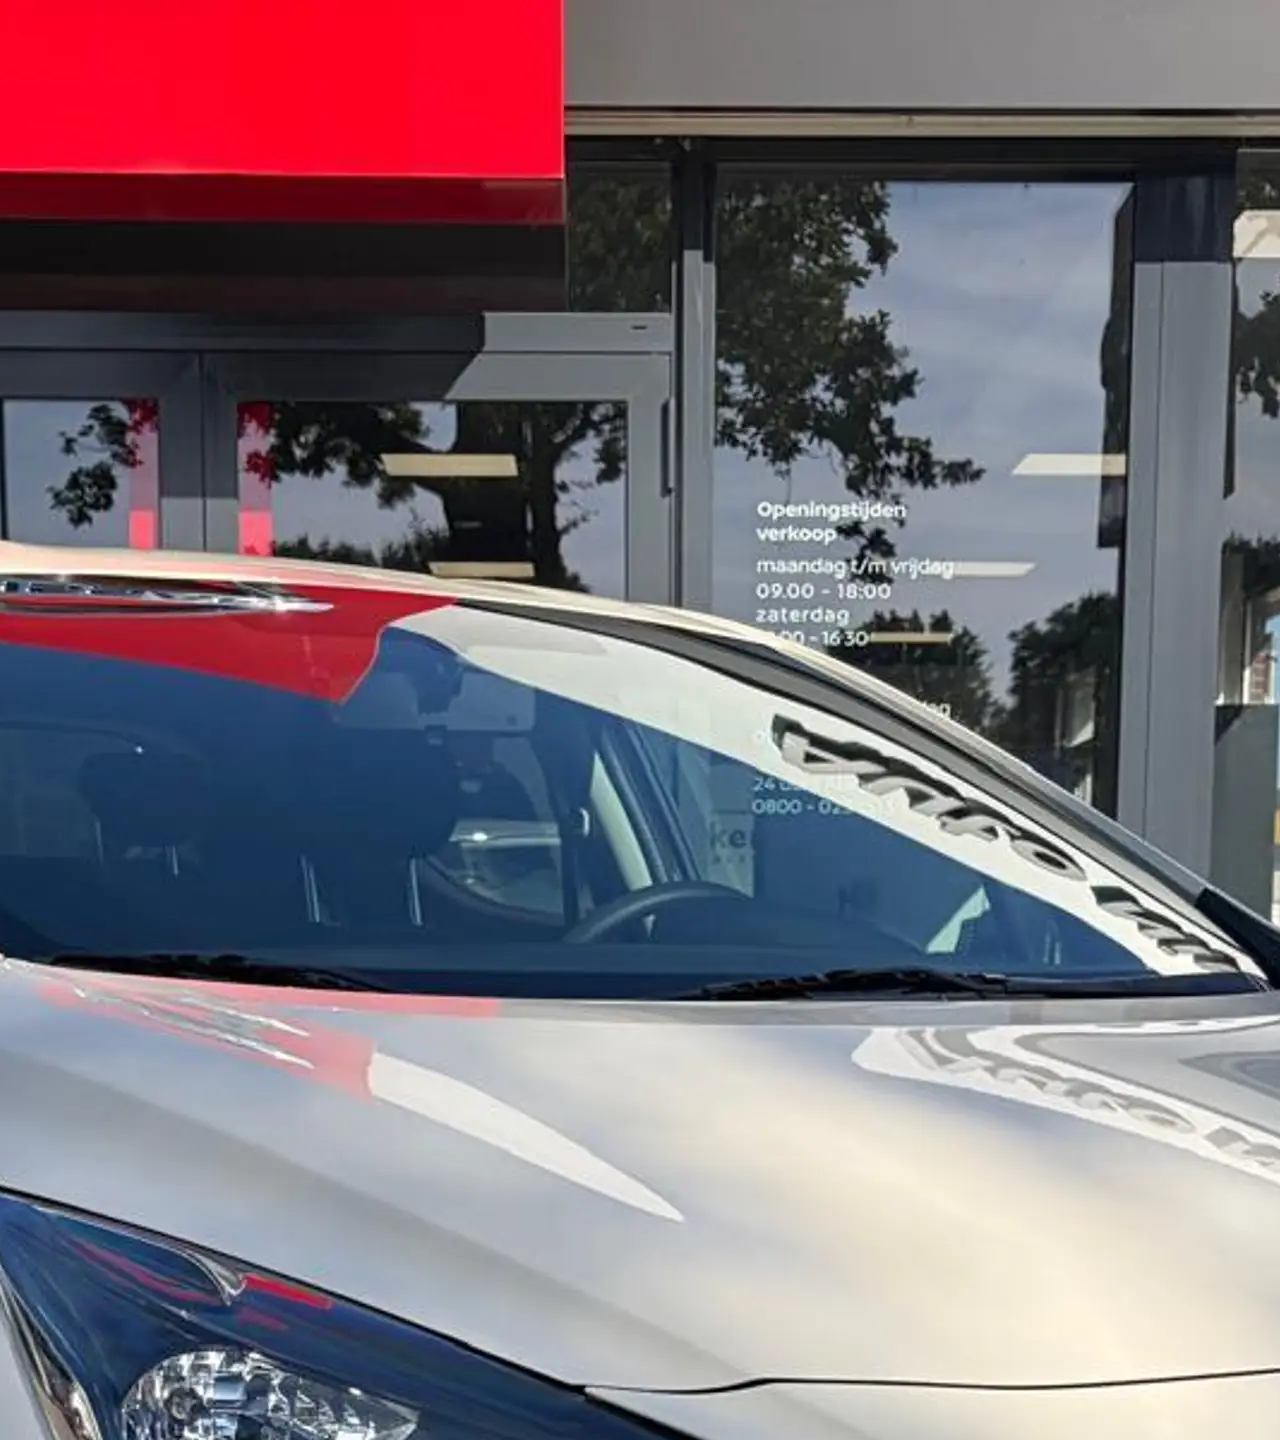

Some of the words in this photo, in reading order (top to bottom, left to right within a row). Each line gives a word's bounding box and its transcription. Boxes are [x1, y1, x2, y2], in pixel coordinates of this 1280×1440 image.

[757, 500, 907, 521] Openingstijden
[756, 524, 837, 545] verkoop
[756, 558, 846, 579] maandag
[850, 557, 887, 575] t/m
[891, 557, 955, 580] vrijdag
[756, 606, 851, 627] zaterdag
[751, 799, 802, 814] 0800
